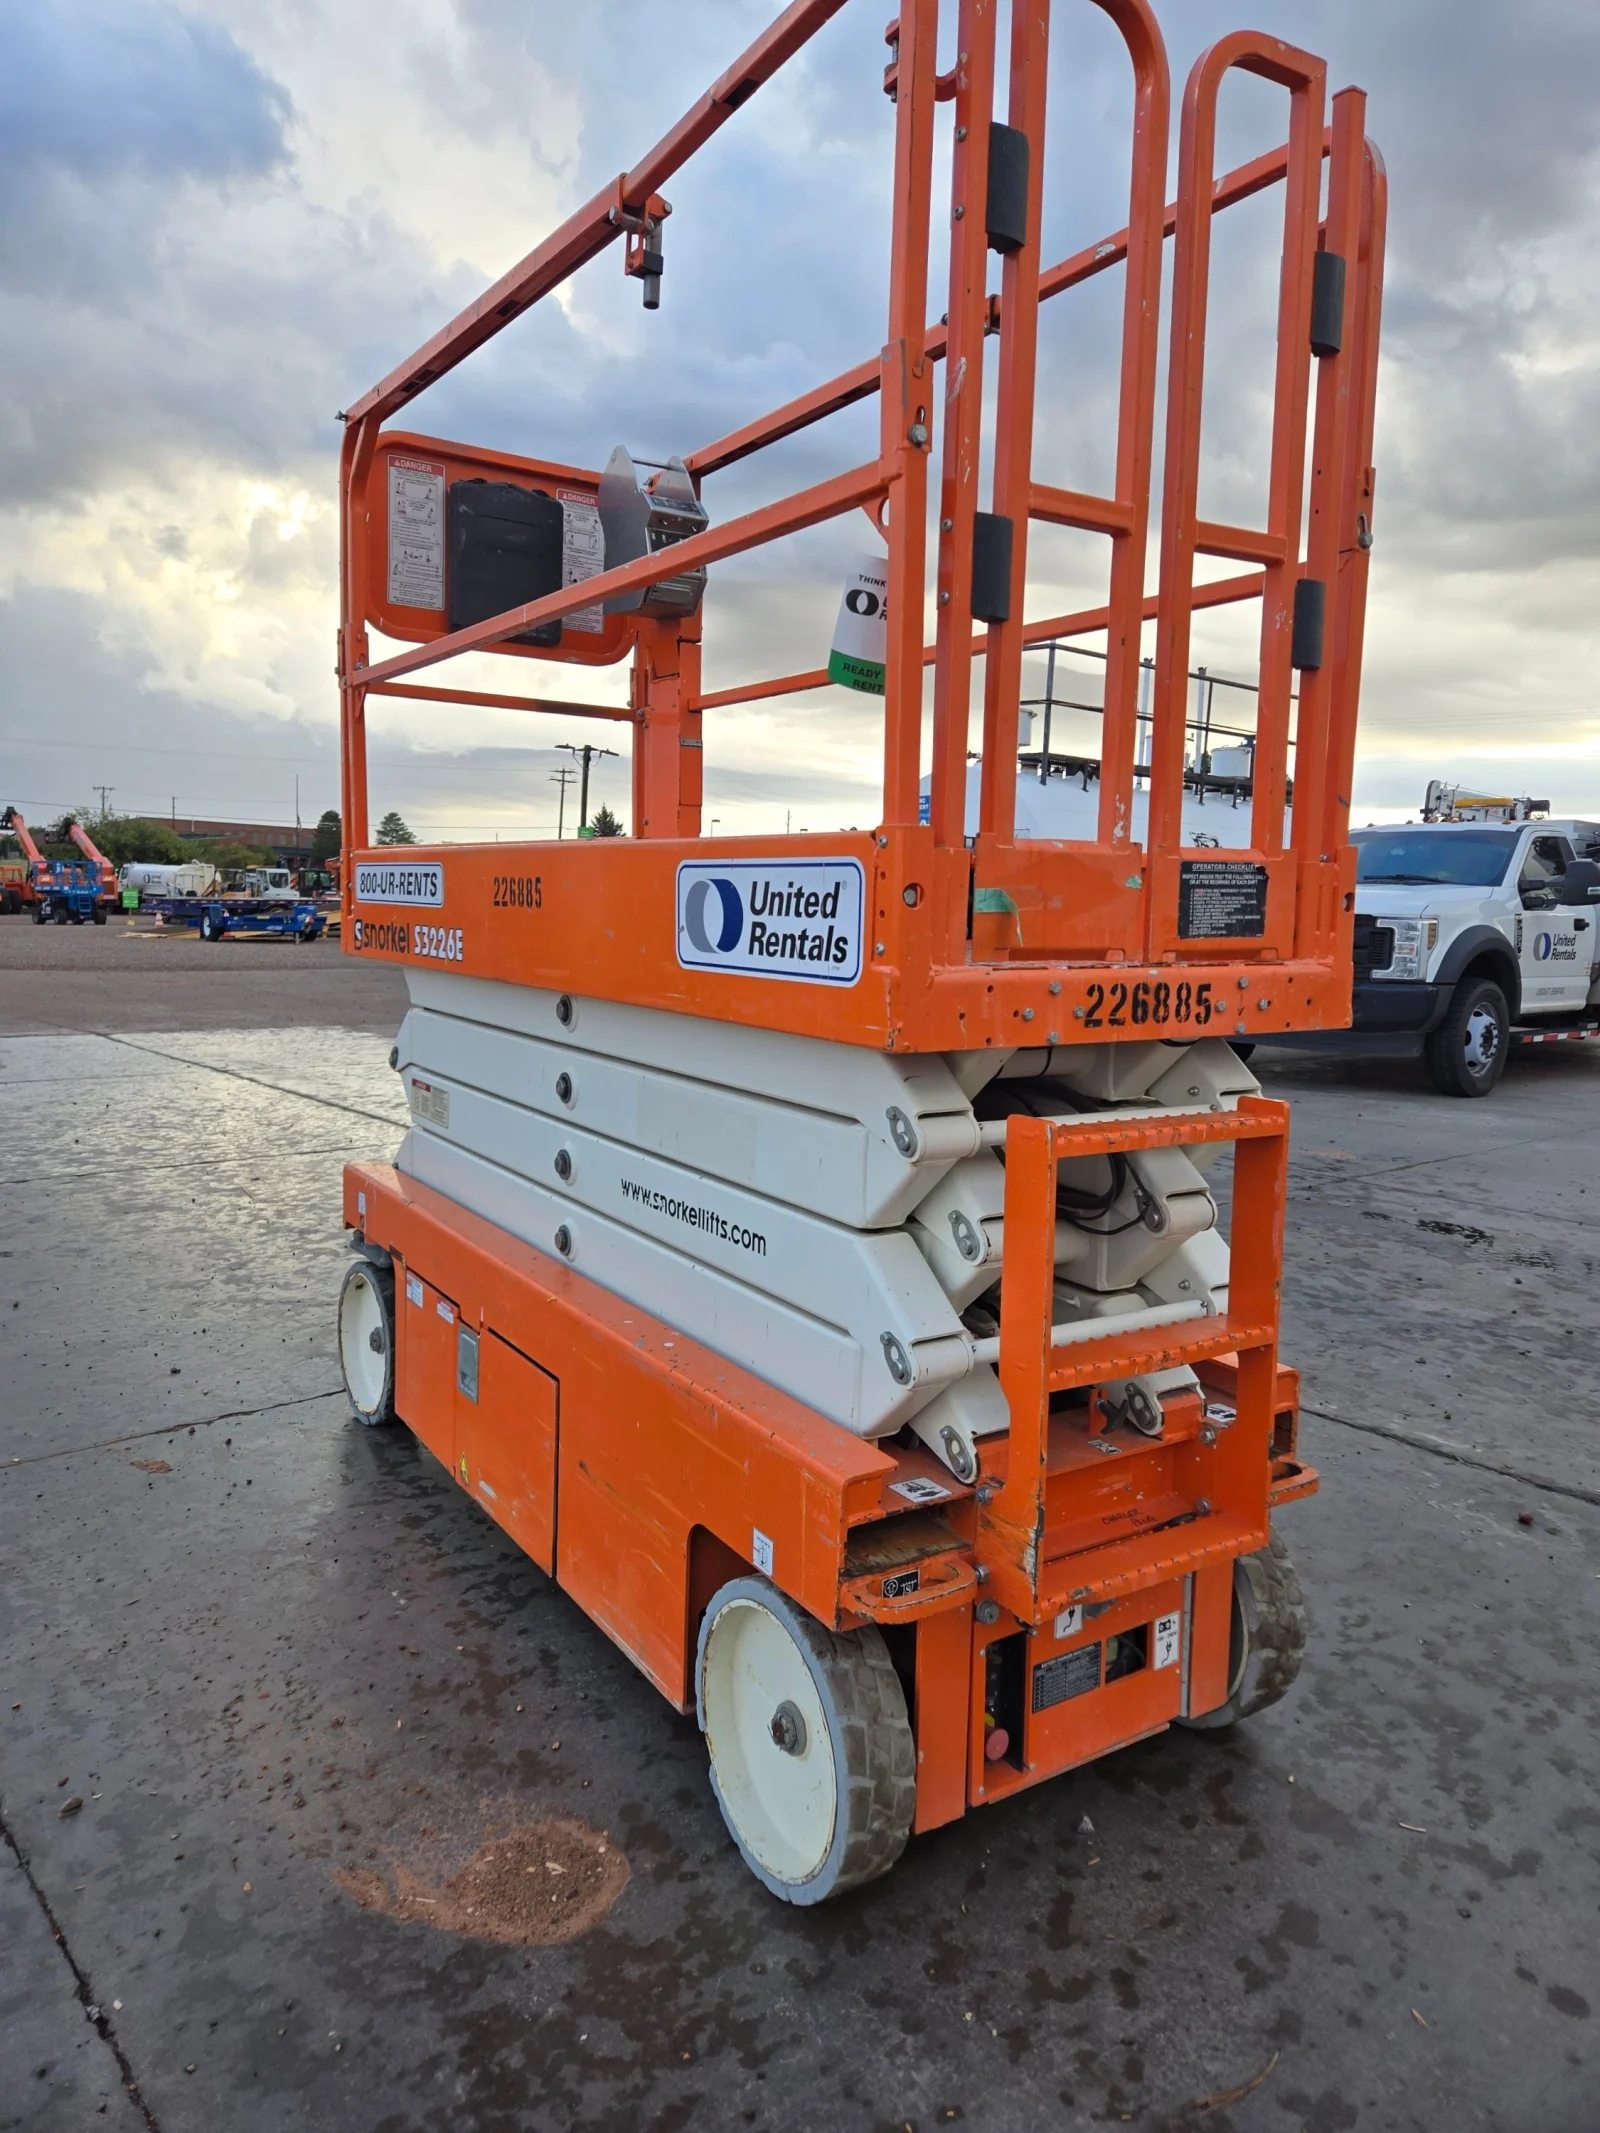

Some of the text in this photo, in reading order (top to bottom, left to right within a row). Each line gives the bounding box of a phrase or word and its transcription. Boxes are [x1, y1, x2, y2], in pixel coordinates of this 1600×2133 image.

[400, 460, 432, 472] DANGER
[568, 494, 595, 504] DANGER
[858, 574, 887, 588] THINK
[842, 662, 881, 679] READY
[852, 679, 885, 693] RENT
[359, 871, 438, 898] 800-UR-RENTS
[493, 876, 542, 909] 226885
[749, 880, 841, 919] United
[414, 924, 464, 962] S3226E
[748, 921, 849, 963] Rentals
[1553, 933, 1577, 947] United
[1550, 948, 1577, 960] Rentals
[1084, 982, 1212, 1028] 226885
[620, 1178, 766, 1257] www.snorkellifts.com
